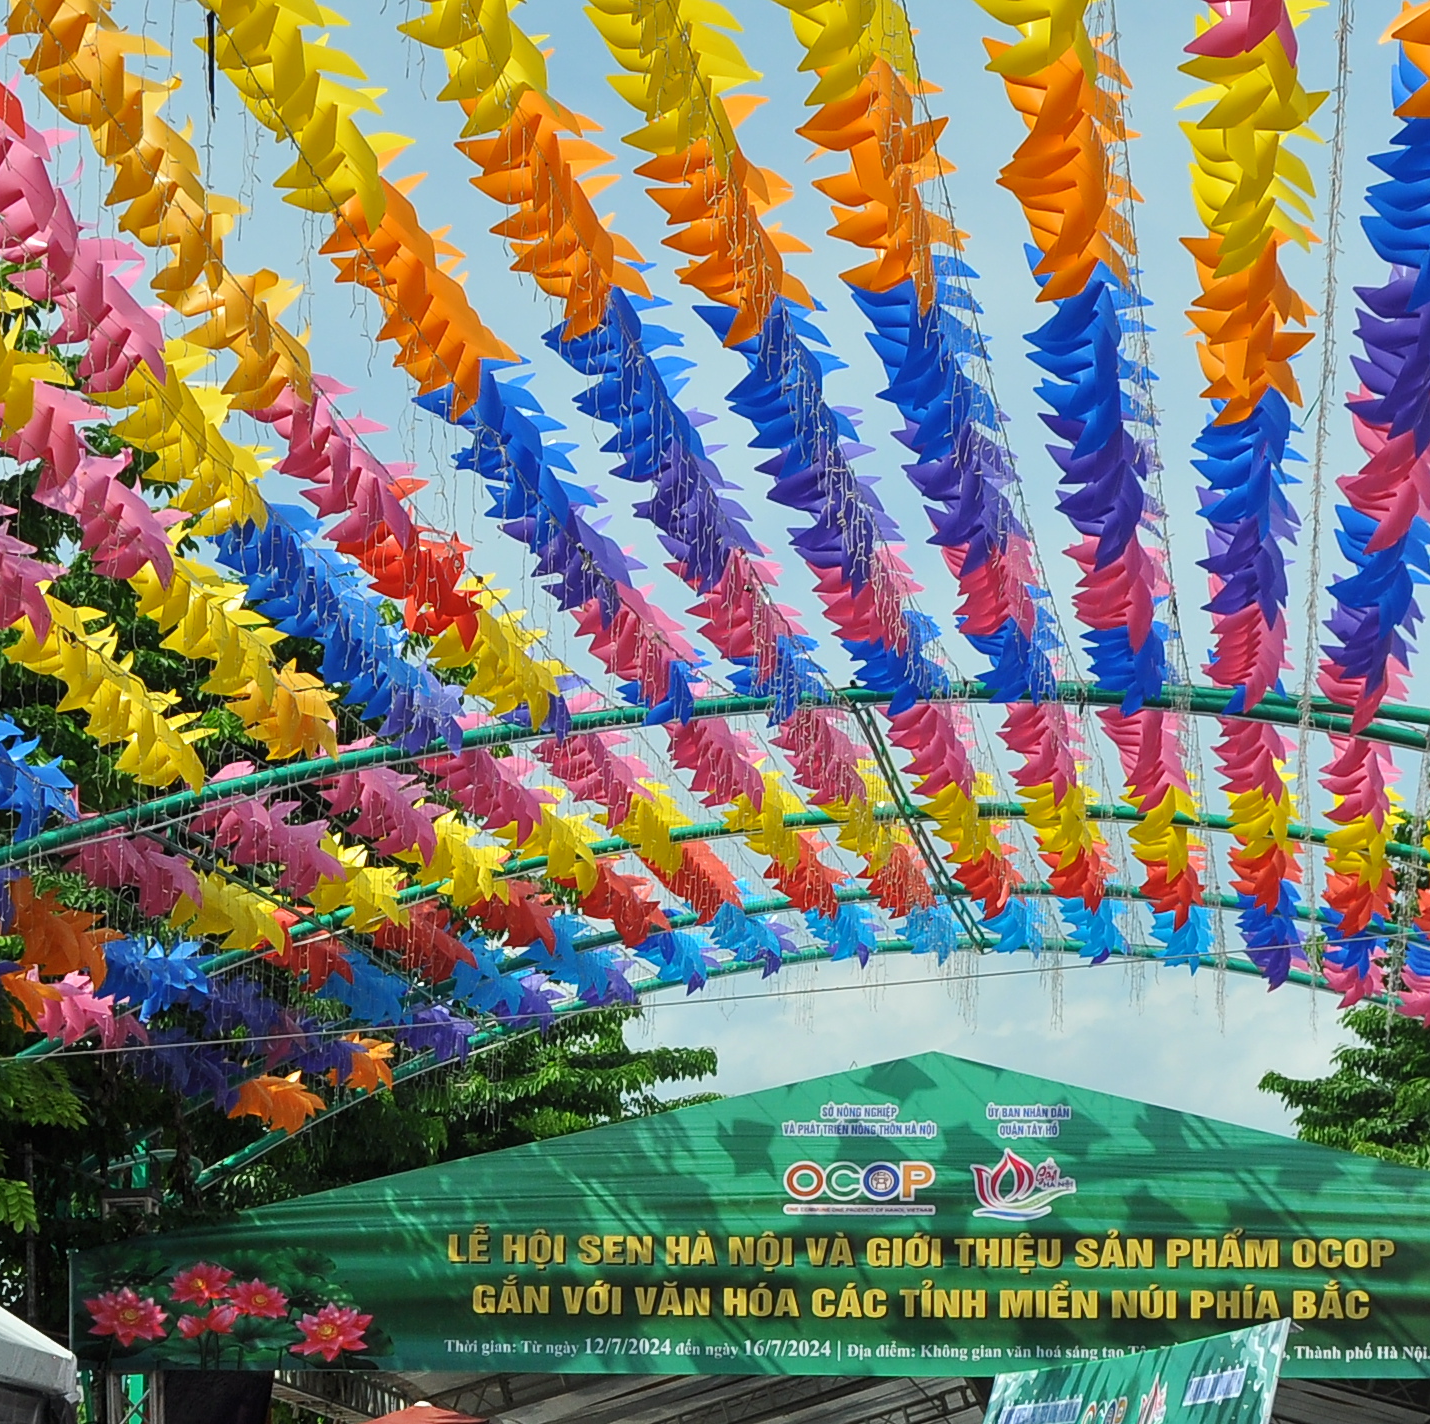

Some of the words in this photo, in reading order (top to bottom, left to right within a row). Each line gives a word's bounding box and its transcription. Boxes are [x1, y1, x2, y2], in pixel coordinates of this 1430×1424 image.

[836, 1103, 862, 1117] NÔNG
[864, 1103, 897, 1119] NGHIỆP
[1002, 1107, 1020, 1118] BAN
[1023, 1104, 1048, 1118] NHÂN
[1051, 1104, 1070, 1118] DÂN
[851, 1121, 876, 1135] NÔNG
[879, 1121, 902, 1135] THÔN
[905, 1121, 917, 1135] HÀ
[919, 1121, 935, 1138] NỘI
[999, 1122, 1024, 1137] QUẬN
[1027, 1122, 1043, 1135] TÂY
[785, 1163, 933, 1198] OCOP
[448, 1224, 489, 1263] LỄ
[503, 1228, 566, 1271] HỘI
[577, 1234, 653, 1265] SEN
[665, 1229, 717, 1266] HÀ
[728, 1231, 794, 1272] NỘI
[805, 1232, 855, 1267] VÀ
[866, 1232, 943, 1267] GIỚI
[954, 1232, 1062, 1274] THIỆU
[1074, 1228, 1154, 1268] SẢN
[1166, 1227, 1280, 1268] PHẨM
[1292, 1238, 1396, 1268] OCOP
[472, 1275, 550, 1315] GẮN
[561, 1279, 623, 1315] VỚI
[634, 1281, 711, 1316] VĂN
[723, 1282, 801, 1317] HÓA
[811, 1283, 888, 1318] CÁC
[899, 1279, 987, 1319] TỈNH
[999, 1280, 1099, 1319] MIỀN
[1111, 1283, 1177, 1319] NÚI
[1190, 1284, 1281, 1320] PHÍA
[1292, 1279, 1371, 1320] BẮC
[444, 1339, 478, 1353] Thời
[481, 1339, 517, 1357] gian:
[521, 1340, 542, 1354] Từ
[545, 1340, 580, 1358] ngày
[584, 1337, 671, 1356] 12/7/2024
[675, 1339, 701, 1356] đến
[705, 1341, 739, 1359] ngày
[743, 1339, 832, 1358] 16/7/2024
[847, 1342, 872, 1359] Địa
[875, 1341, 916, 1359] điểm:
[920, 1342, 969, 1361] Không
[972, 1344, 1002, 1361] gian
[1006, 1345, 1032, 1359] văn
[1035, 1344, 1062, 1359] hoá
[1065, 1345, 1099, 1361] sáng
[1293, 1344, 1342, 1360] Thành
[1345, 1342, 1373, 1362] phố
[1377, 1344, 1399, 1360] Hà
